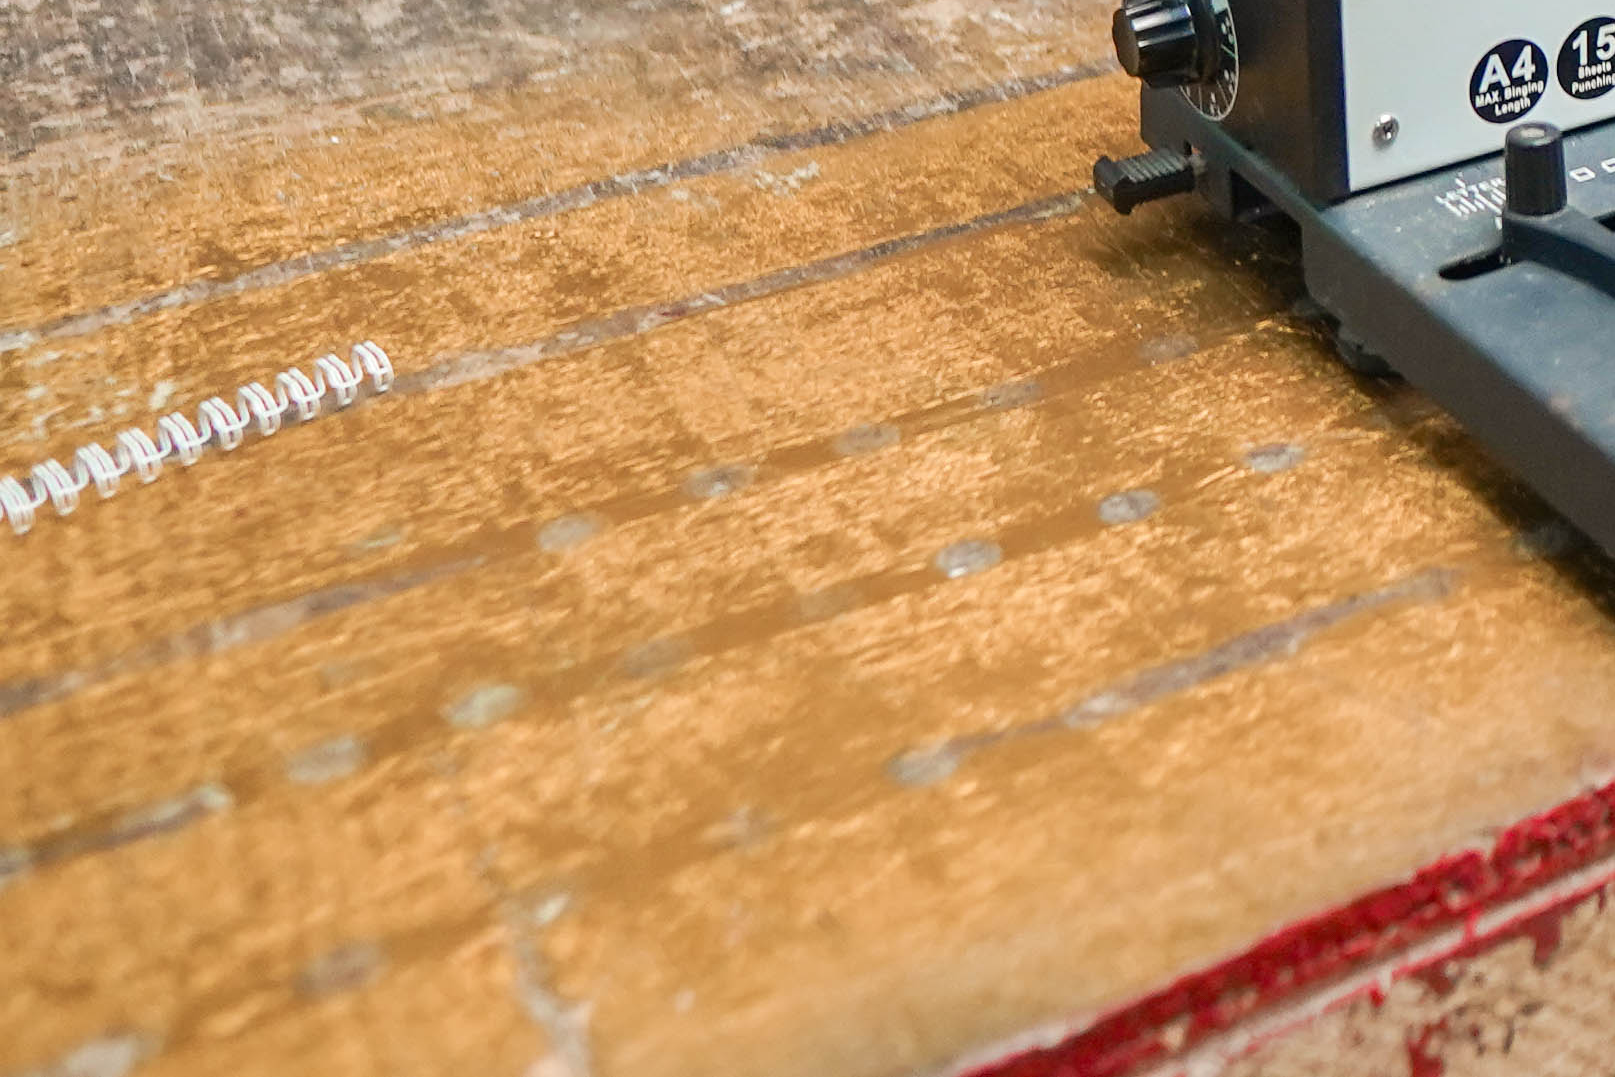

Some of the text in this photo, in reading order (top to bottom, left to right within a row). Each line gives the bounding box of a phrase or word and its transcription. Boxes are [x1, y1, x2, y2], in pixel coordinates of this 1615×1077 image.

[1478, 44, 1535, 93] A4
[1578, 61, 1612, 79] Sheets
[1494, 98, 1531, 117] Length
